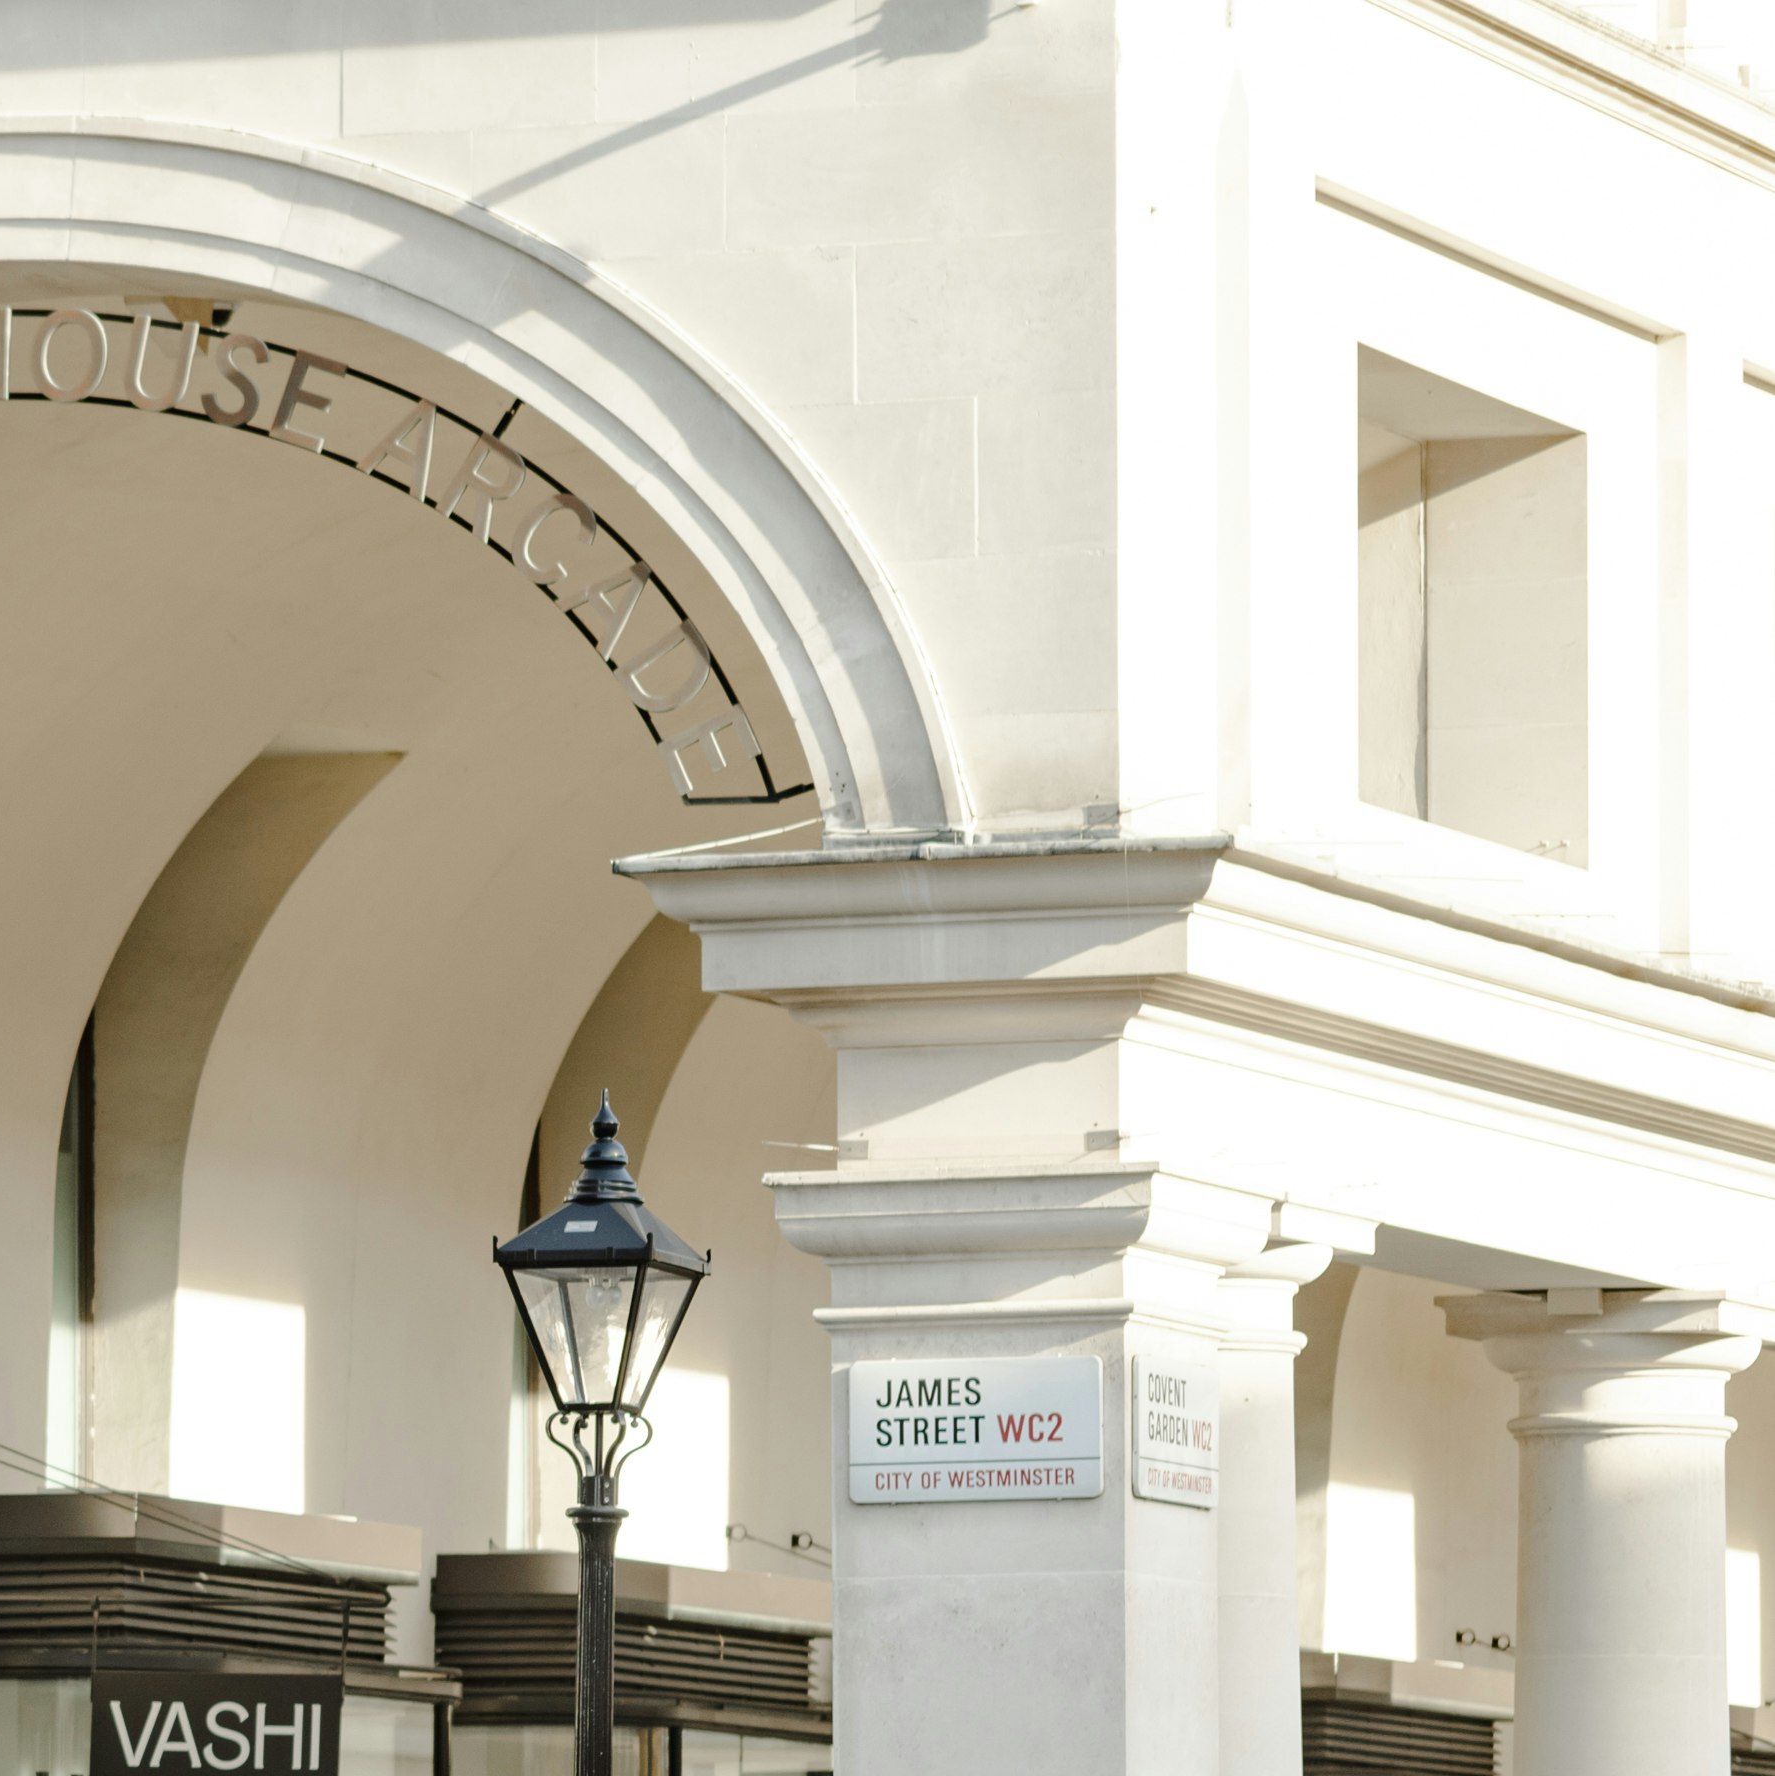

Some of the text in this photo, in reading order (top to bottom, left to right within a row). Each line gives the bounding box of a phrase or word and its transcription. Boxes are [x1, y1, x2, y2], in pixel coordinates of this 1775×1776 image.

[358, 398, 762, 797] ARCADE
[876, 1377, 981, 1408] JAMES
[1148, 1373, 1187, 1408] COVENT
[876, 1412, 1063, 1447] STREET WC2
[1148, 1410, 1212, 1451] GARDEN WC2
[875, 1467, 1075, 1490] CITY OF WESTMINSTER
[1148, 1467, 1212, 1494] CITY OF WESTMINSTER
[109, 1700, 322, 1770] VASHI
